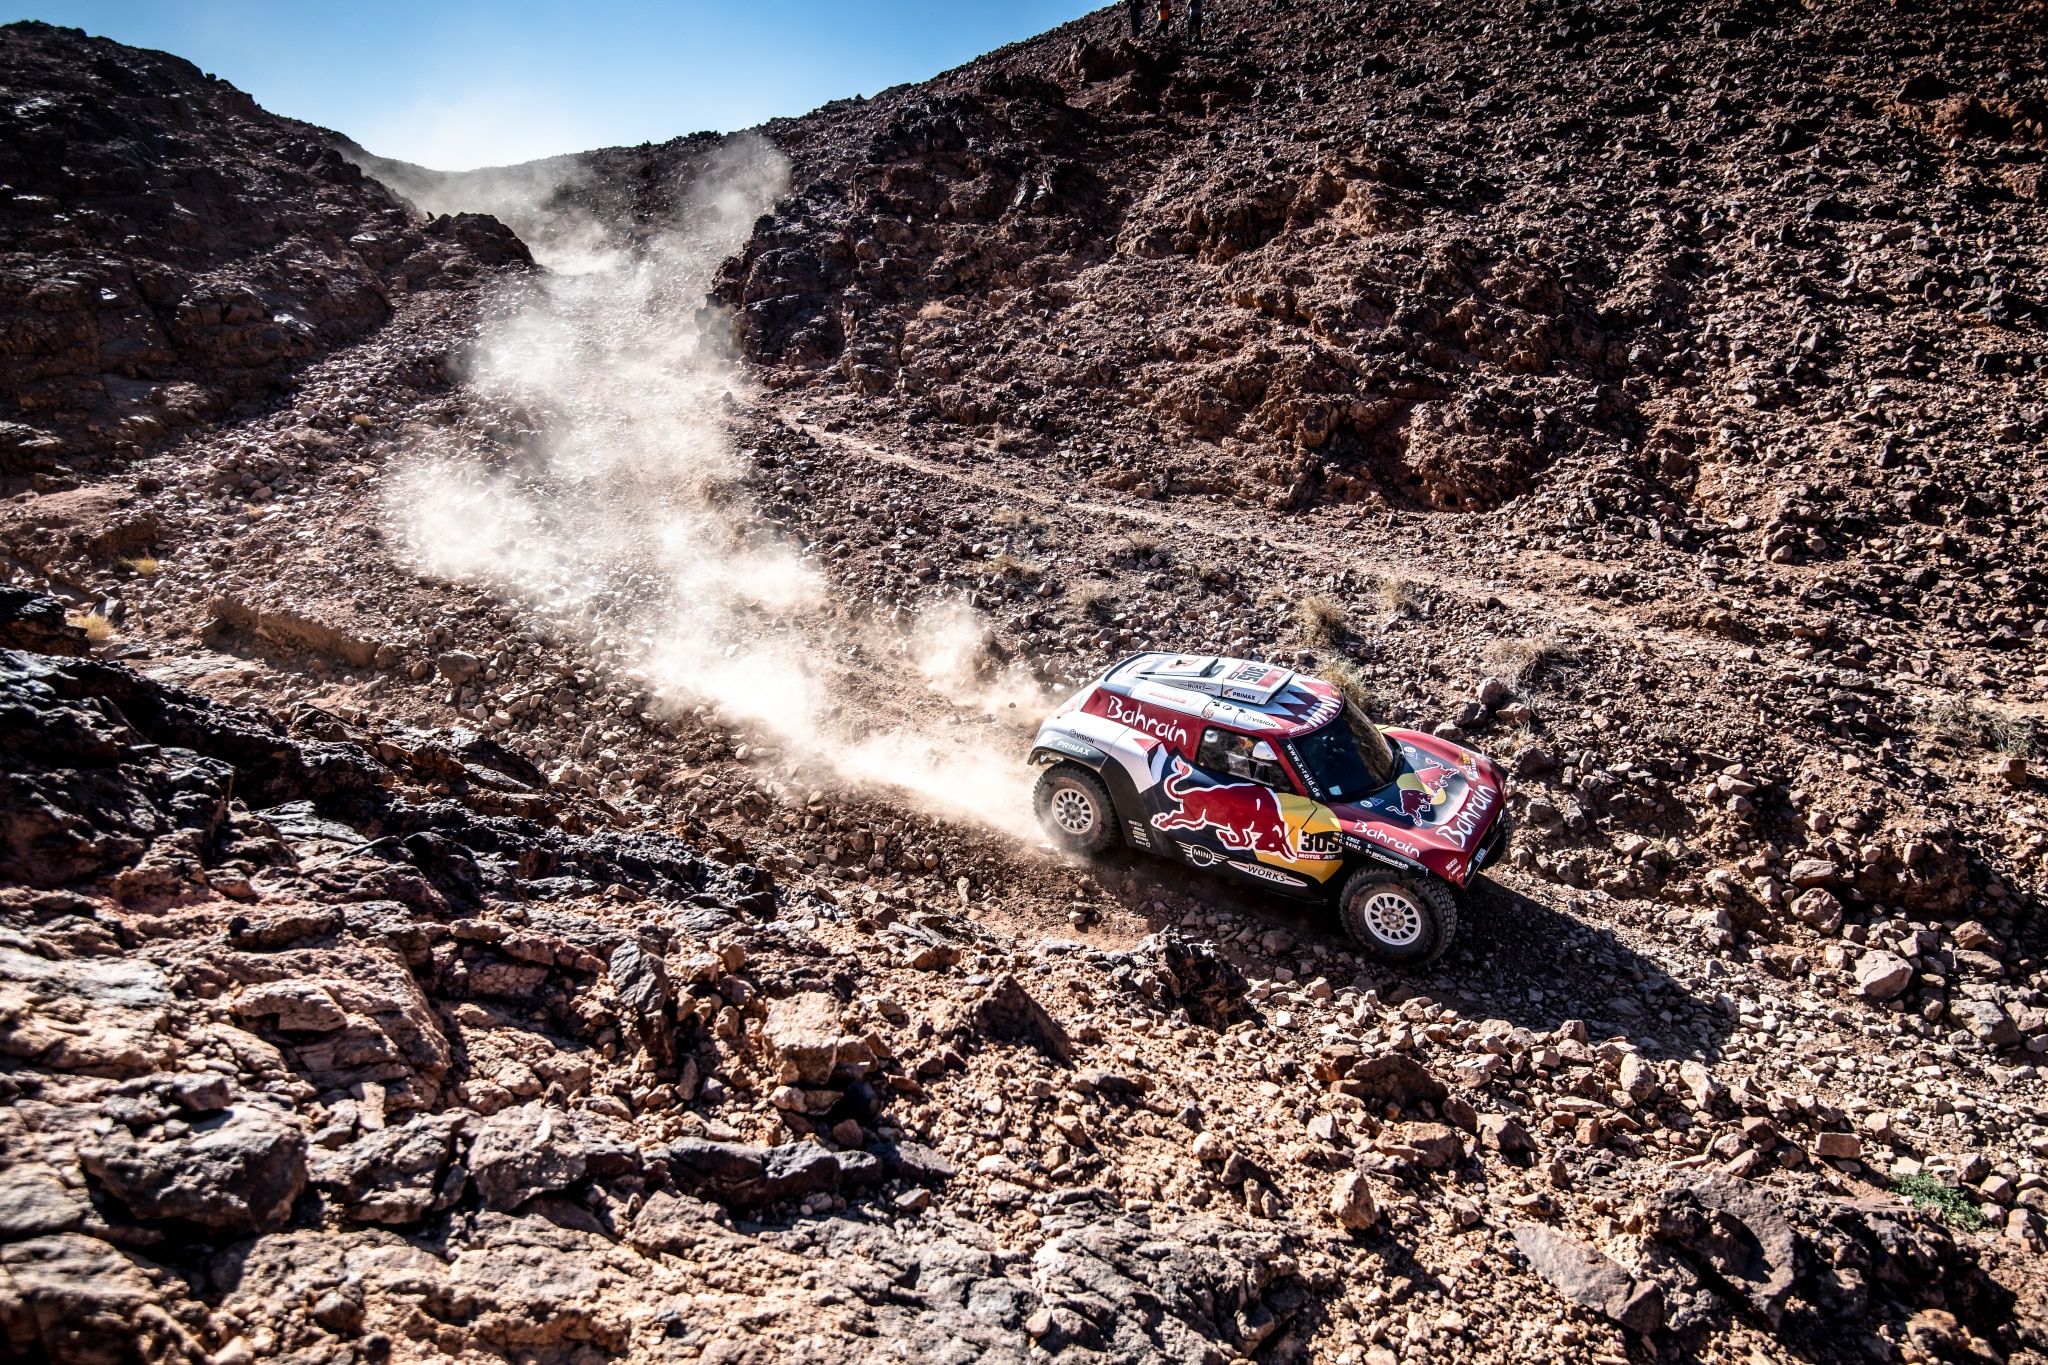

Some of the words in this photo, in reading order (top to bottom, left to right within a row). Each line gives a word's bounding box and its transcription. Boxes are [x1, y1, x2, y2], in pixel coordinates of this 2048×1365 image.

[1237, 666, 1269, 682] 305
[1232, 691, 1256, 700] PRIMAX
[1298, 695, 1341, 728] MINI
[1107, 695, 1187, 746] Bahrain
[1252, 717, 1276, 728] VISION
[1289, 724, 1310, 734] MOTUL
[1076, 732, 1094, 744] VISION
[1057, 740, 1091, 756] PRIMAX
[1286, 743, 1321, 797] www.x-raid.de
[1436, 785, 1496, 848] Bahrain
[1354, 820, 1420, 857] Bahrain
[1193, 848, 1211, 860] MINI
[1248, 865, 1286, 882] WORKS
